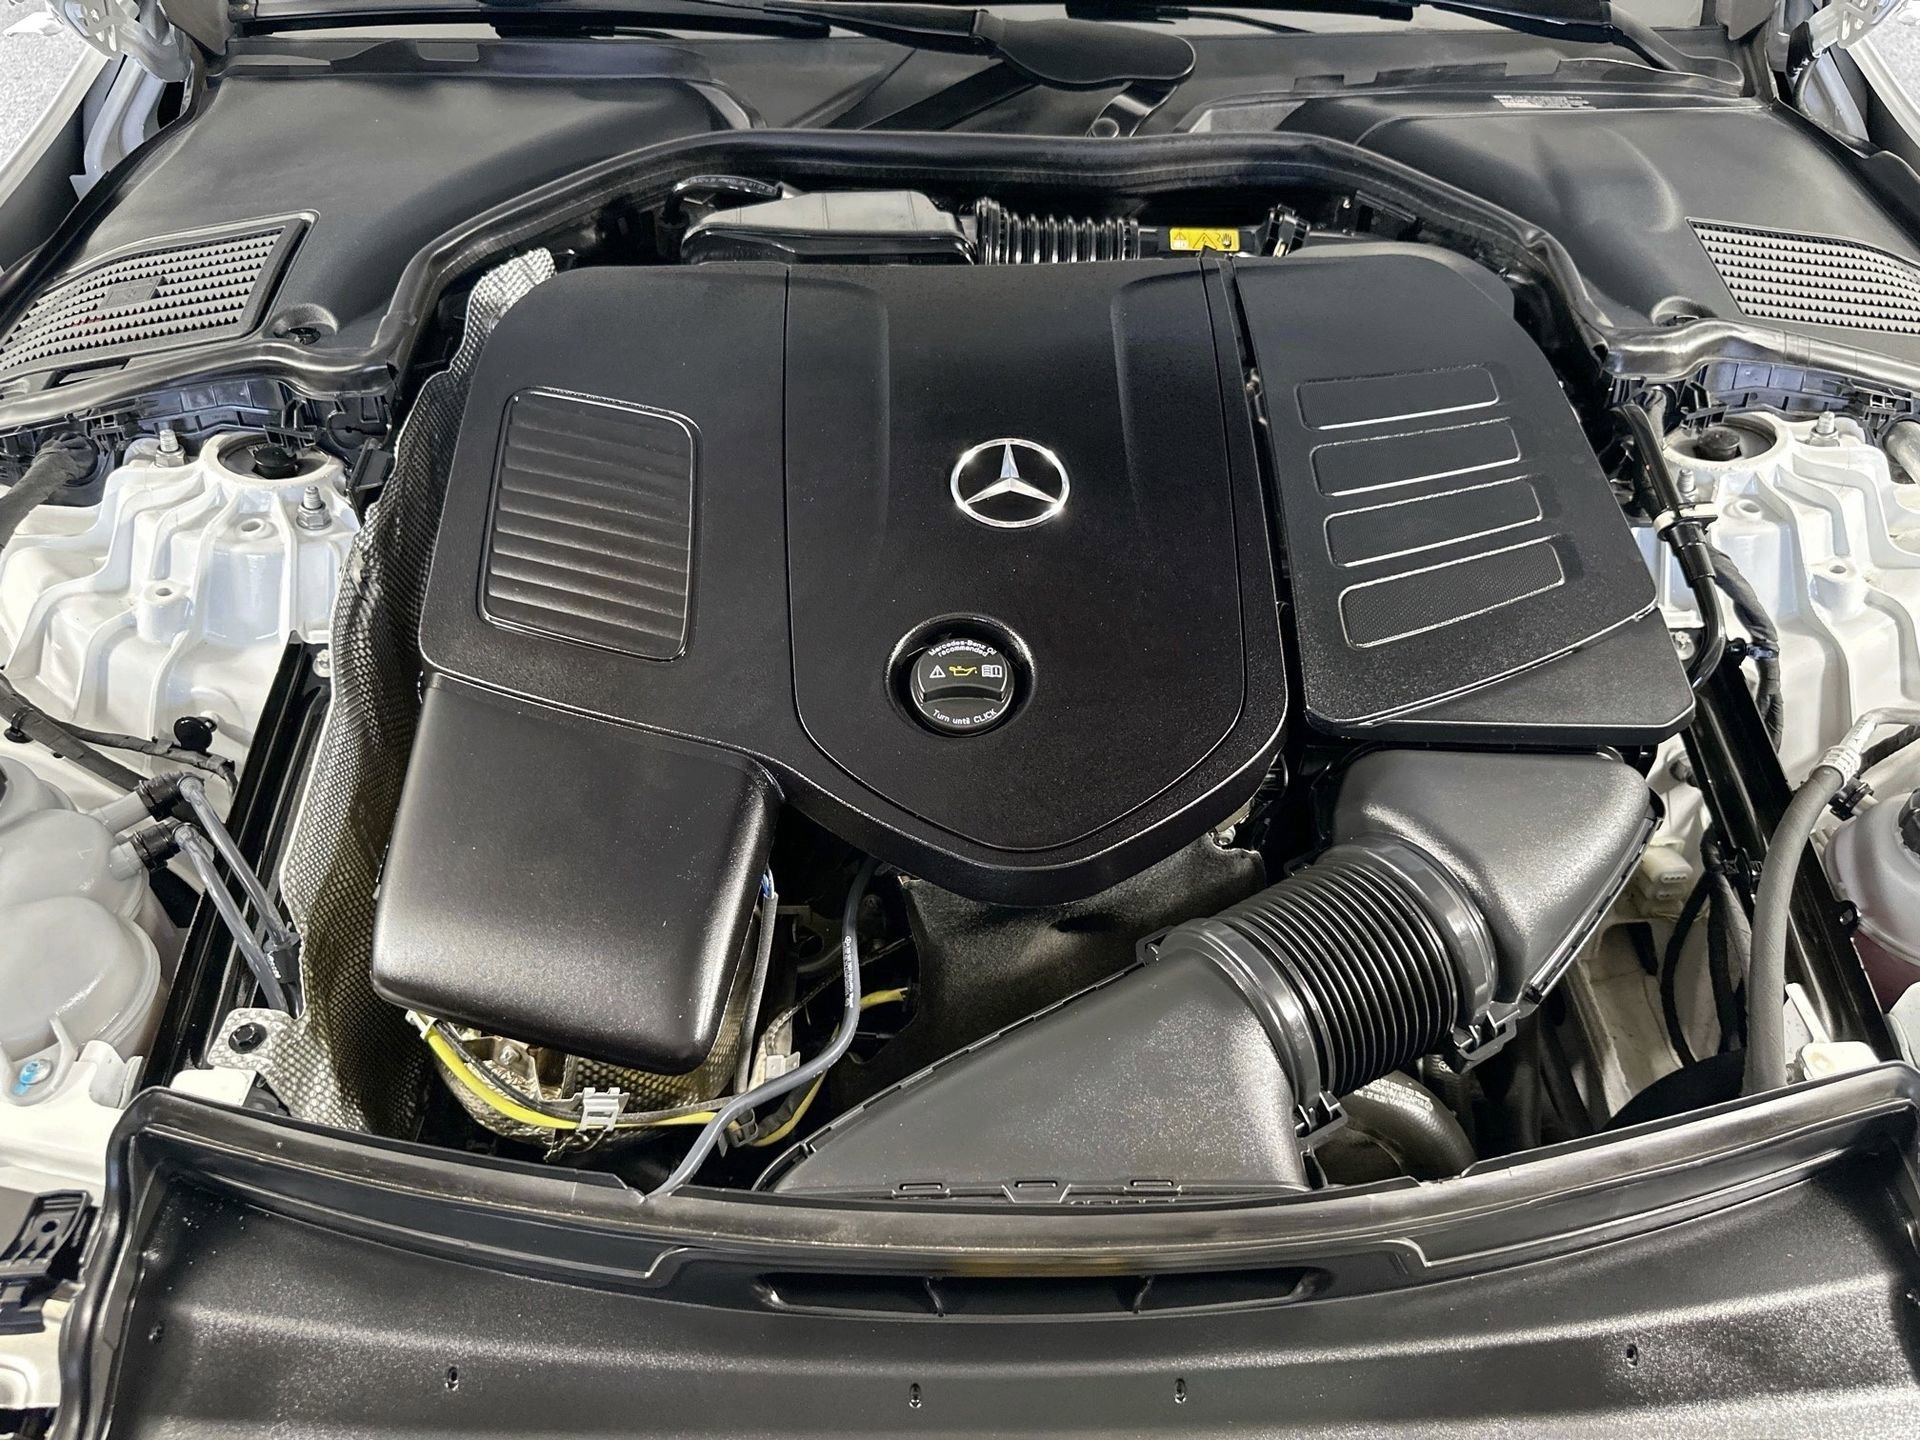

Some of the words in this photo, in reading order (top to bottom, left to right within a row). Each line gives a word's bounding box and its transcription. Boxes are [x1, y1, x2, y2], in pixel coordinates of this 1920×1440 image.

[928, 640, 986, 656] Mercedes-Benz
[938, 645, 988, 657] recommended
[932, 709, 950, 722] Turn
[973, 708, 997, 723] CLICK
